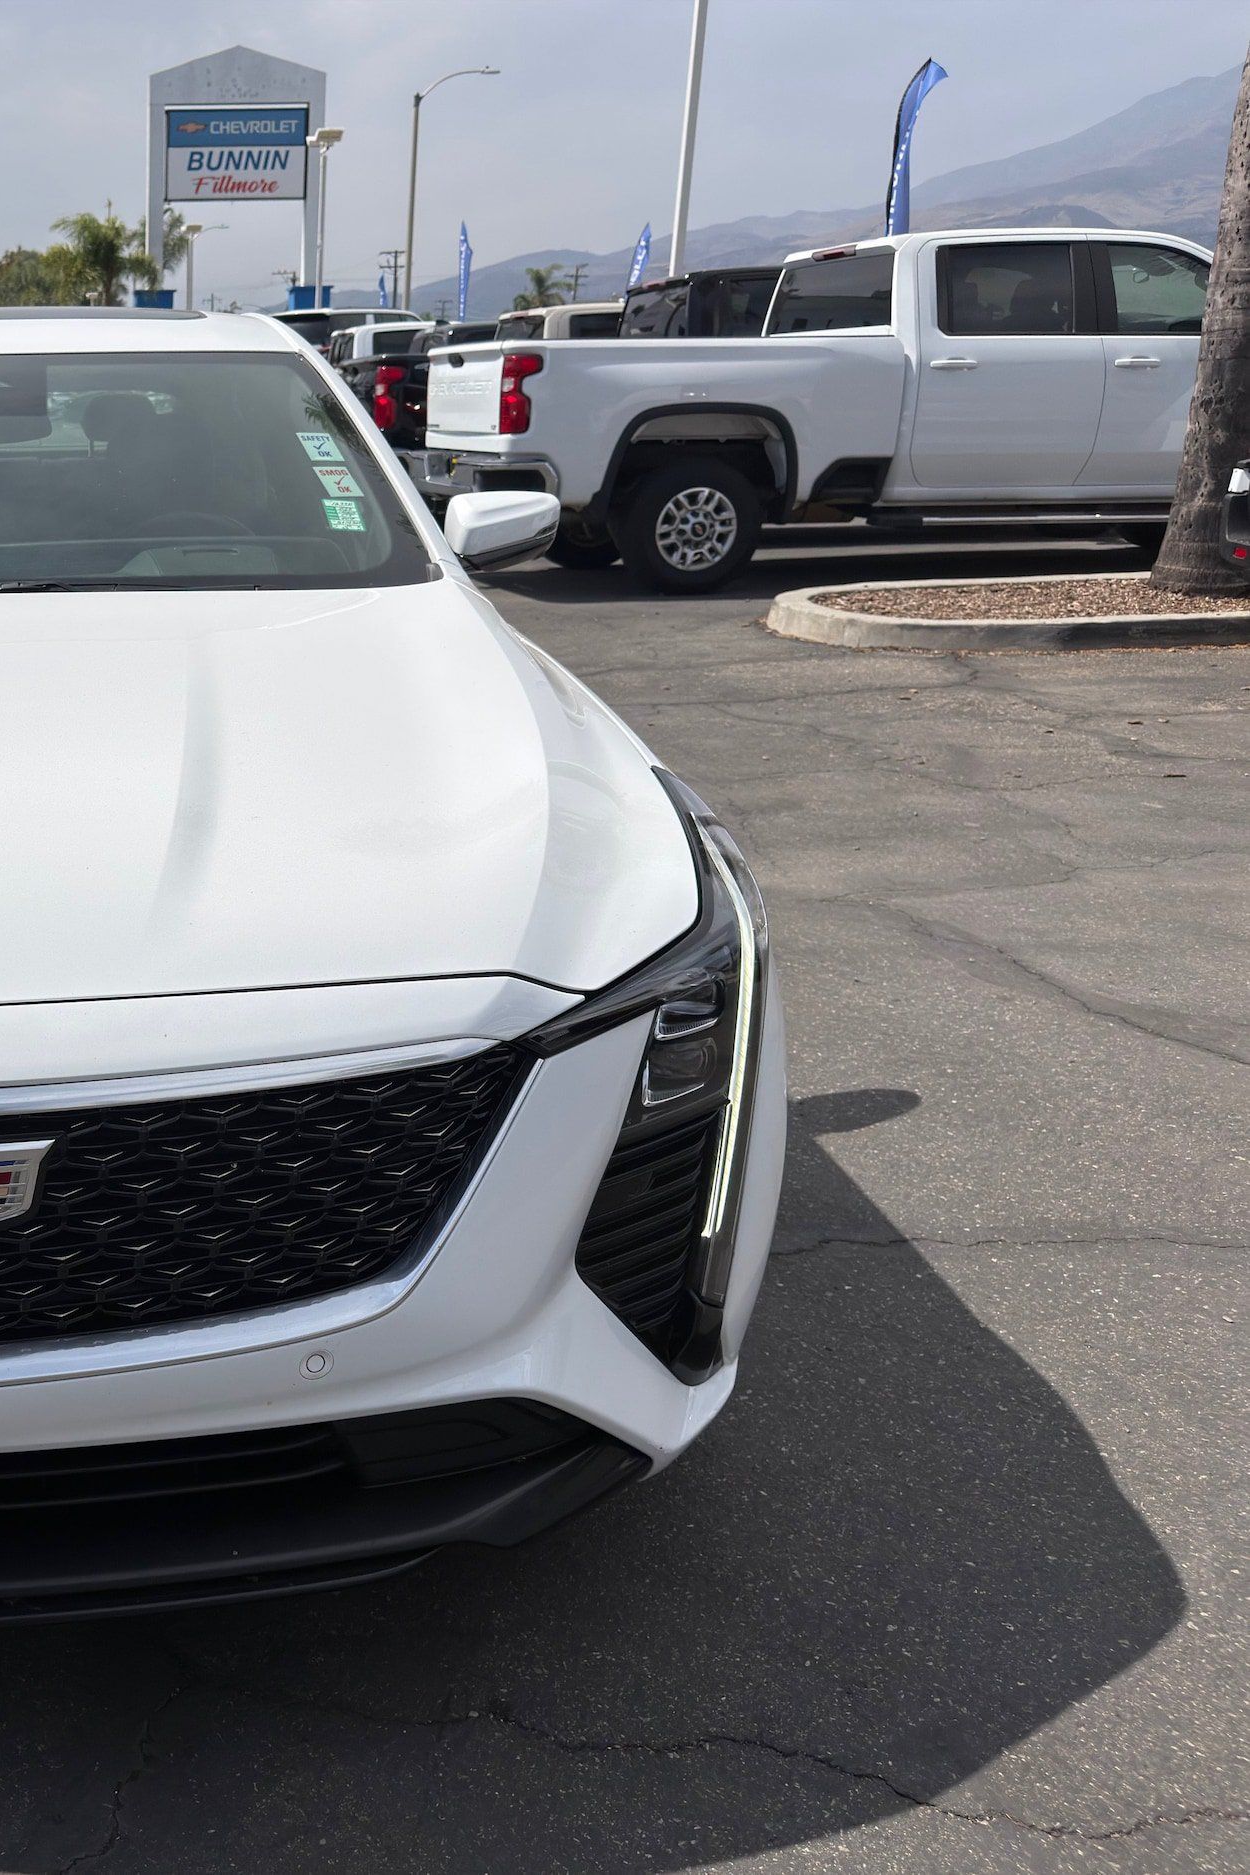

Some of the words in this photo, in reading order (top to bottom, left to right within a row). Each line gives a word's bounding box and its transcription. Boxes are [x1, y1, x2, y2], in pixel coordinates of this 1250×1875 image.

[210, 120, 298, 134] CHEVROLET
[187, 150, 290, 171] BUNNIN
[191, 175, 280, 195] Fillmore
[318, 450, 332, 458] OK
